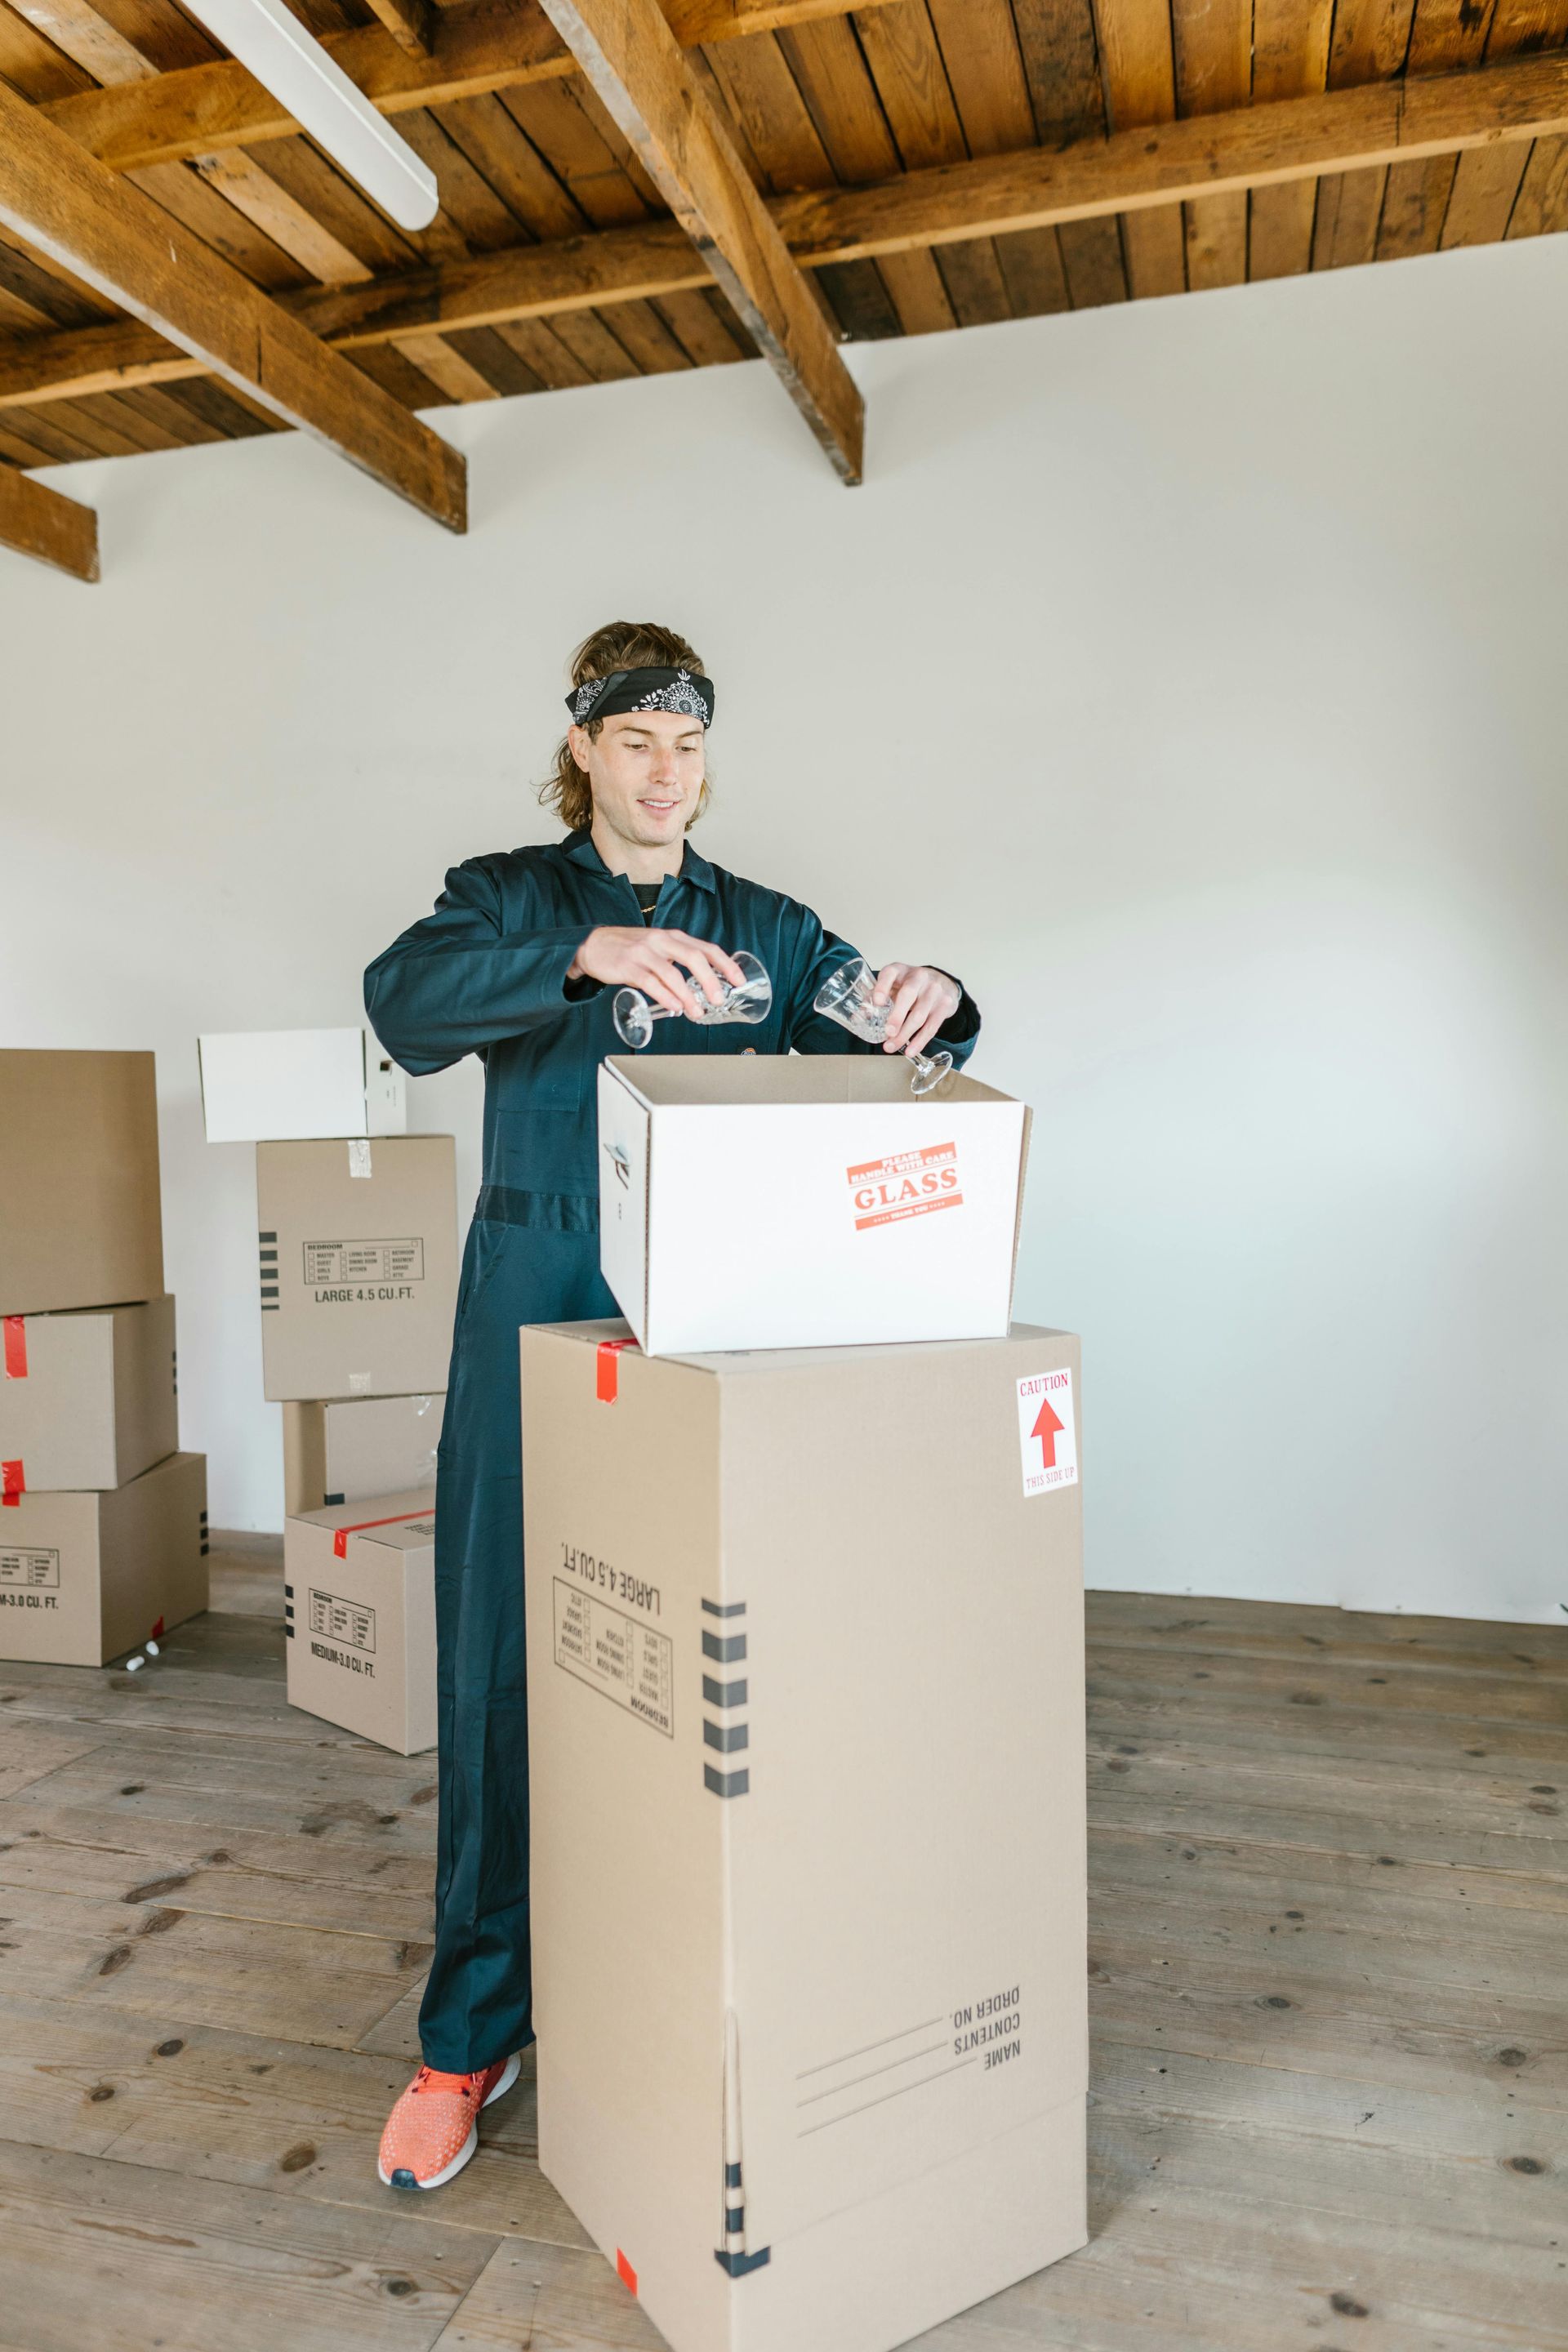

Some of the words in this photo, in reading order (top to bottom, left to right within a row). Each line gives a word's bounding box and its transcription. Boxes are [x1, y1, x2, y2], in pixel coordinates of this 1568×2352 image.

[851, 1167, 894, 1183] HANDLE
[895, 1159, 924, 1173] WITH
[925, 1151, 955, 1165] CARE
[882, 1152, 921, 1168] PLEASE
[854, 1168, 958, 1209] GLASS
[315, 1290, 354, 1303] LARGE
[357, 1288, 375, 1301] 4.5
[1020, 1373, 1068, 1396] CAUTION
[1027, 1475, 1045, 1490] THIS
[1046, 1470, 1062, 1485] SIDE
[1065, 1467, 1075, 1478] UP
[599, 1561, 617, 1591] 4.5
[26, 1595, 42, 1609] CU.
[45, 1597, 59, 1610] FT.
[620, 1571, 660, 1616] LARGE
[311, 1642, 350, 1668] MEDIUM-3.0
[351, 1657, 363, 1674] CU.
[365, 1662, 376, 1678] FT.
[630, 1695, 669, 1728] BEDROOM
[949, 2007, 972, 2029] NO.
[977, 1984, 1020, 2020] ORDER
[954, 2012, 1020, 2056] CONTENTS
[984, 2039, 1021, 2071] NAME
